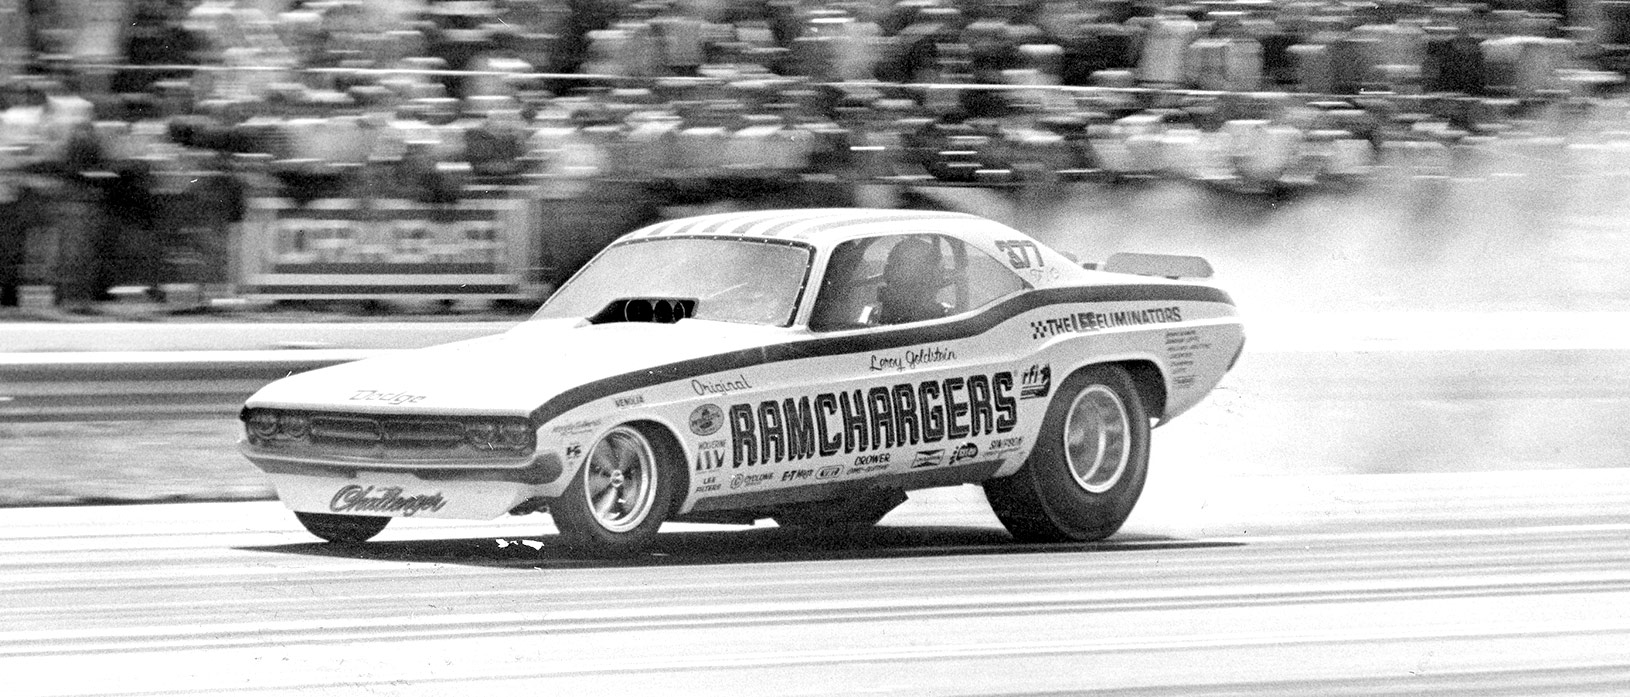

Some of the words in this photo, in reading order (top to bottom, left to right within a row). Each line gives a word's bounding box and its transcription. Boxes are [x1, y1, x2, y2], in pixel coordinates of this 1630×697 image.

[994, 240, 1044, 269] 377
[1046, 317, 1070, 336] THE
[1070, 311, 1099, 332] LEE
[1096, 306, 1183, 329] ELIMINATORS
[869, 354, 905, 372] Leroy
[905, 346, 957, 369] Goldstein
[349, 389, 427, 405] Dodge
[691, 374, 752, 396] Original
[729, 371, 1017, 469] RAMCHARGERS
[854, 453, 891, 466] CROWER
[703, 477, 716, 485] LEE
[330, 484, 447, 517] Challenger
